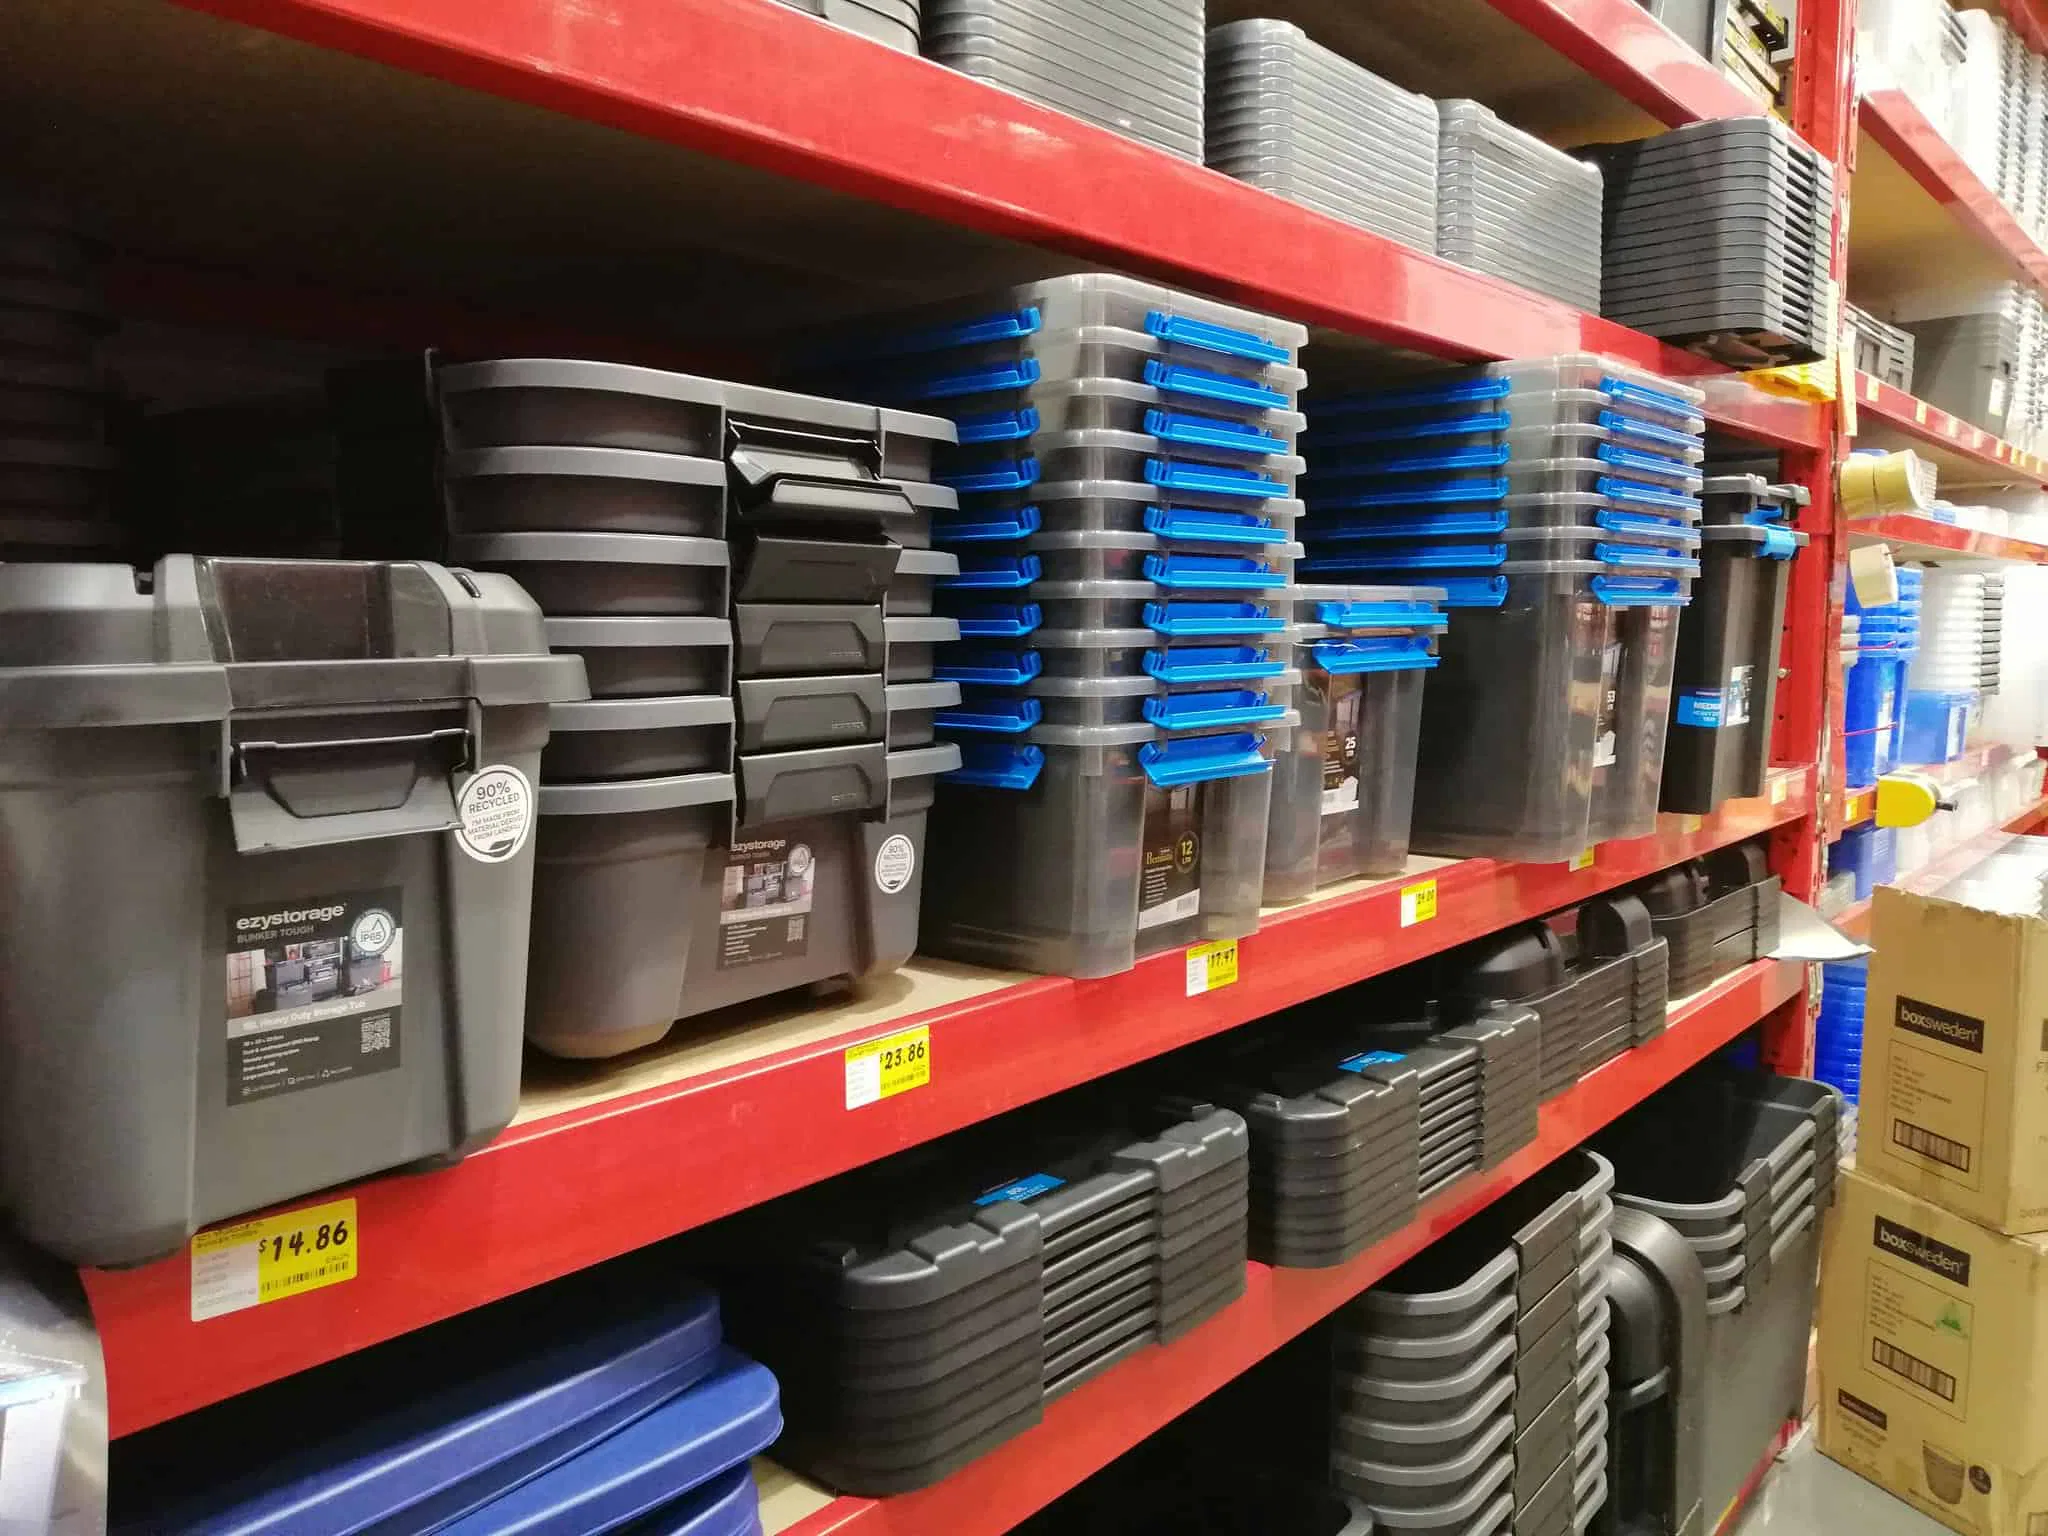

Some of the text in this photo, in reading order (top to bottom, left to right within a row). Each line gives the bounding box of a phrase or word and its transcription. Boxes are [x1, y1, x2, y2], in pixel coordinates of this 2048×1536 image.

[1344, 736, 1356, 750] 25
[476, 780, 511, 801] 90%
[469, 792, 520, 814] RECYCLED
[1181, 840, 1193, 857] 12
[236, 905, 345, 931] ezystorage
[237, 924, 315, 944] BUNKER TOUGH
[360, 930, 381, 942] IP65
[1901, 1006, 1976, 1042] boxsweden
[880, 1041, 925, 1070] $23.86
[258, 1220, 348, 1263] $14.86
[1880, 1225, 1960, 1275] boxsweden
